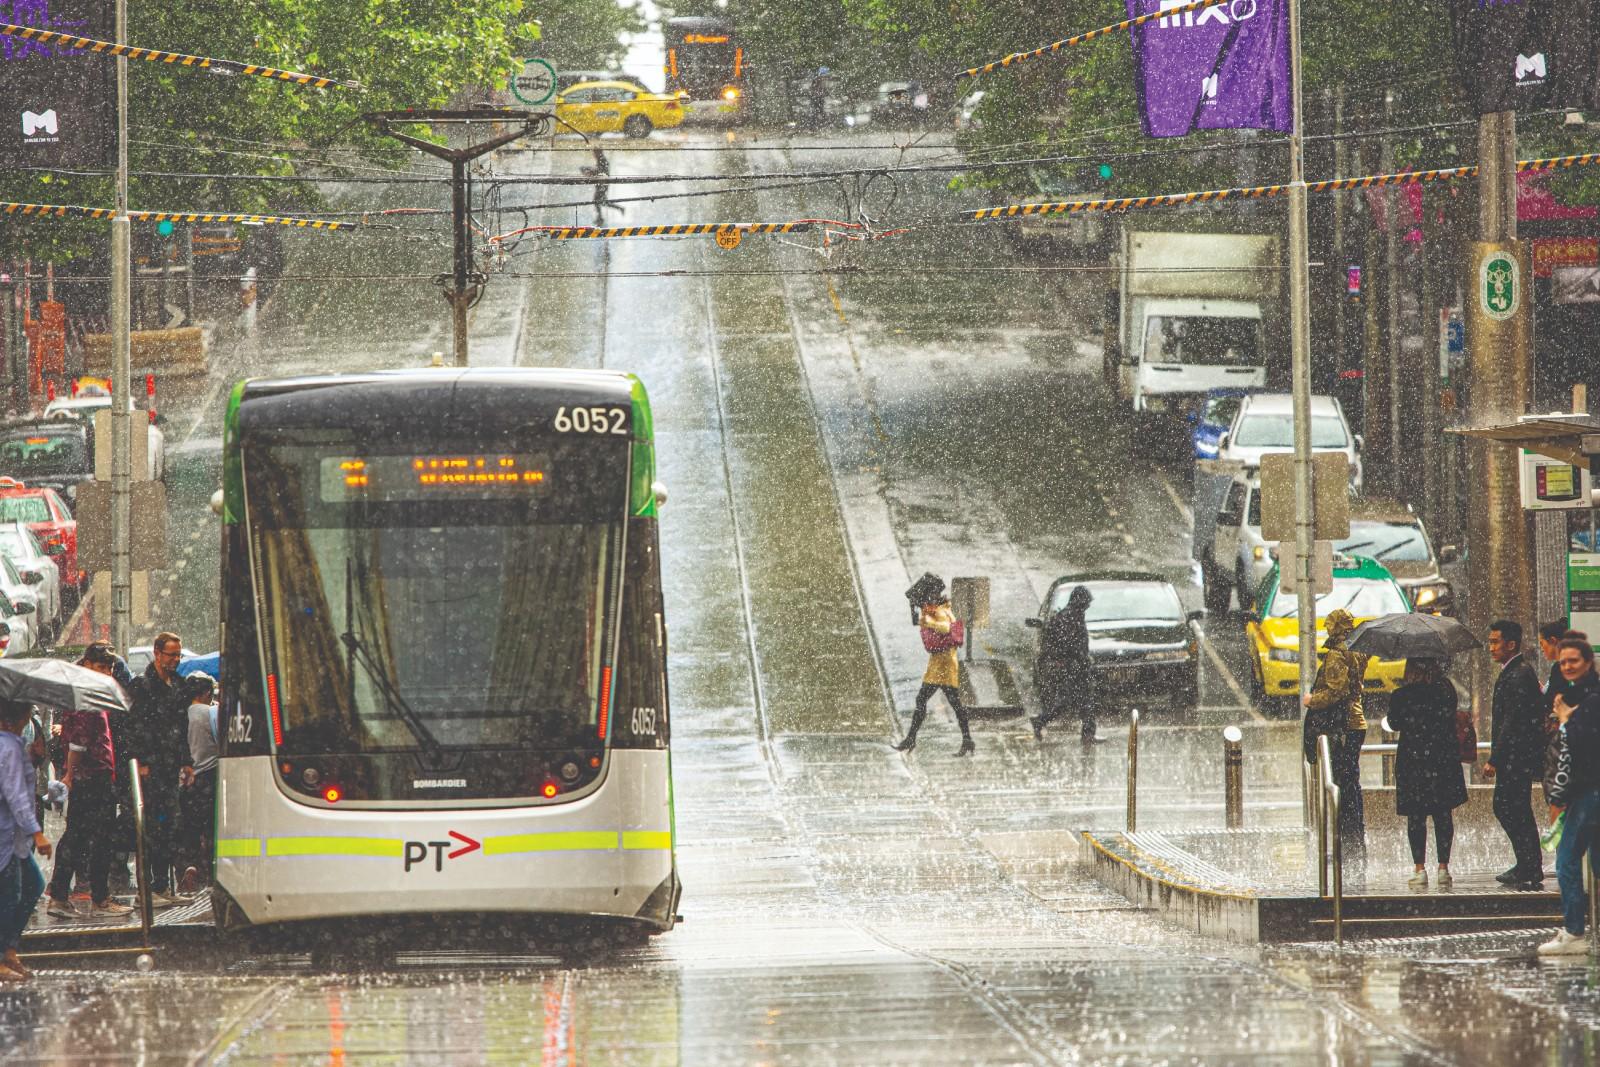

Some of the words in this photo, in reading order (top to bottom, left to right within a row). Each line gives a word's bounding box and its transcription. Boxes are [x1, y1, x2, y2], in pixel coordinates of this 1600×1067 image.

[719, 237, 737, 246] OFF
[554, 406, 628, 434] 6052
[228, 714, 252, 744] 6052
[631, 707, 657, 736] 6052
[413, 779, 467, 789] BOMBARDIER
